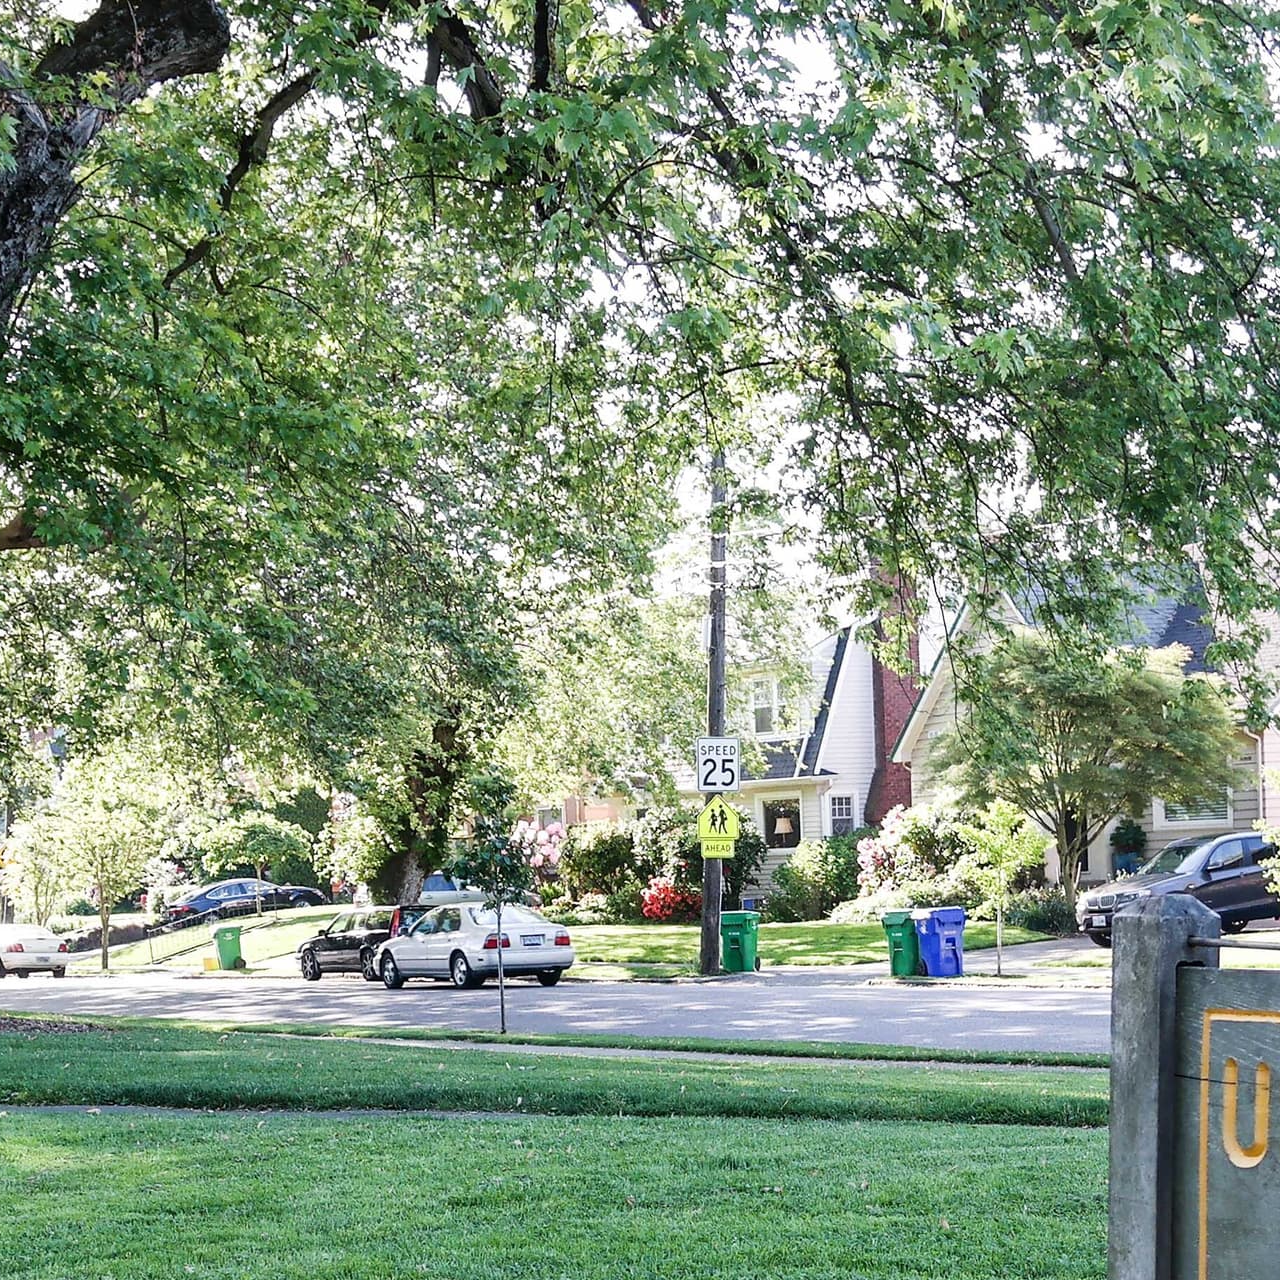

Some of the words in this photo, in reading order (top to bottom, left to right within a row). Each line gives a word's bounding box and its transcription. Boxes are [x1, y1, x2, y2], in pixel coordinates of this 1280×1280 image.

[700, 745, 736, 756] SPEED
[702, 758, 735, 787] 25
[704, 844, 731, 853] AHEAD
